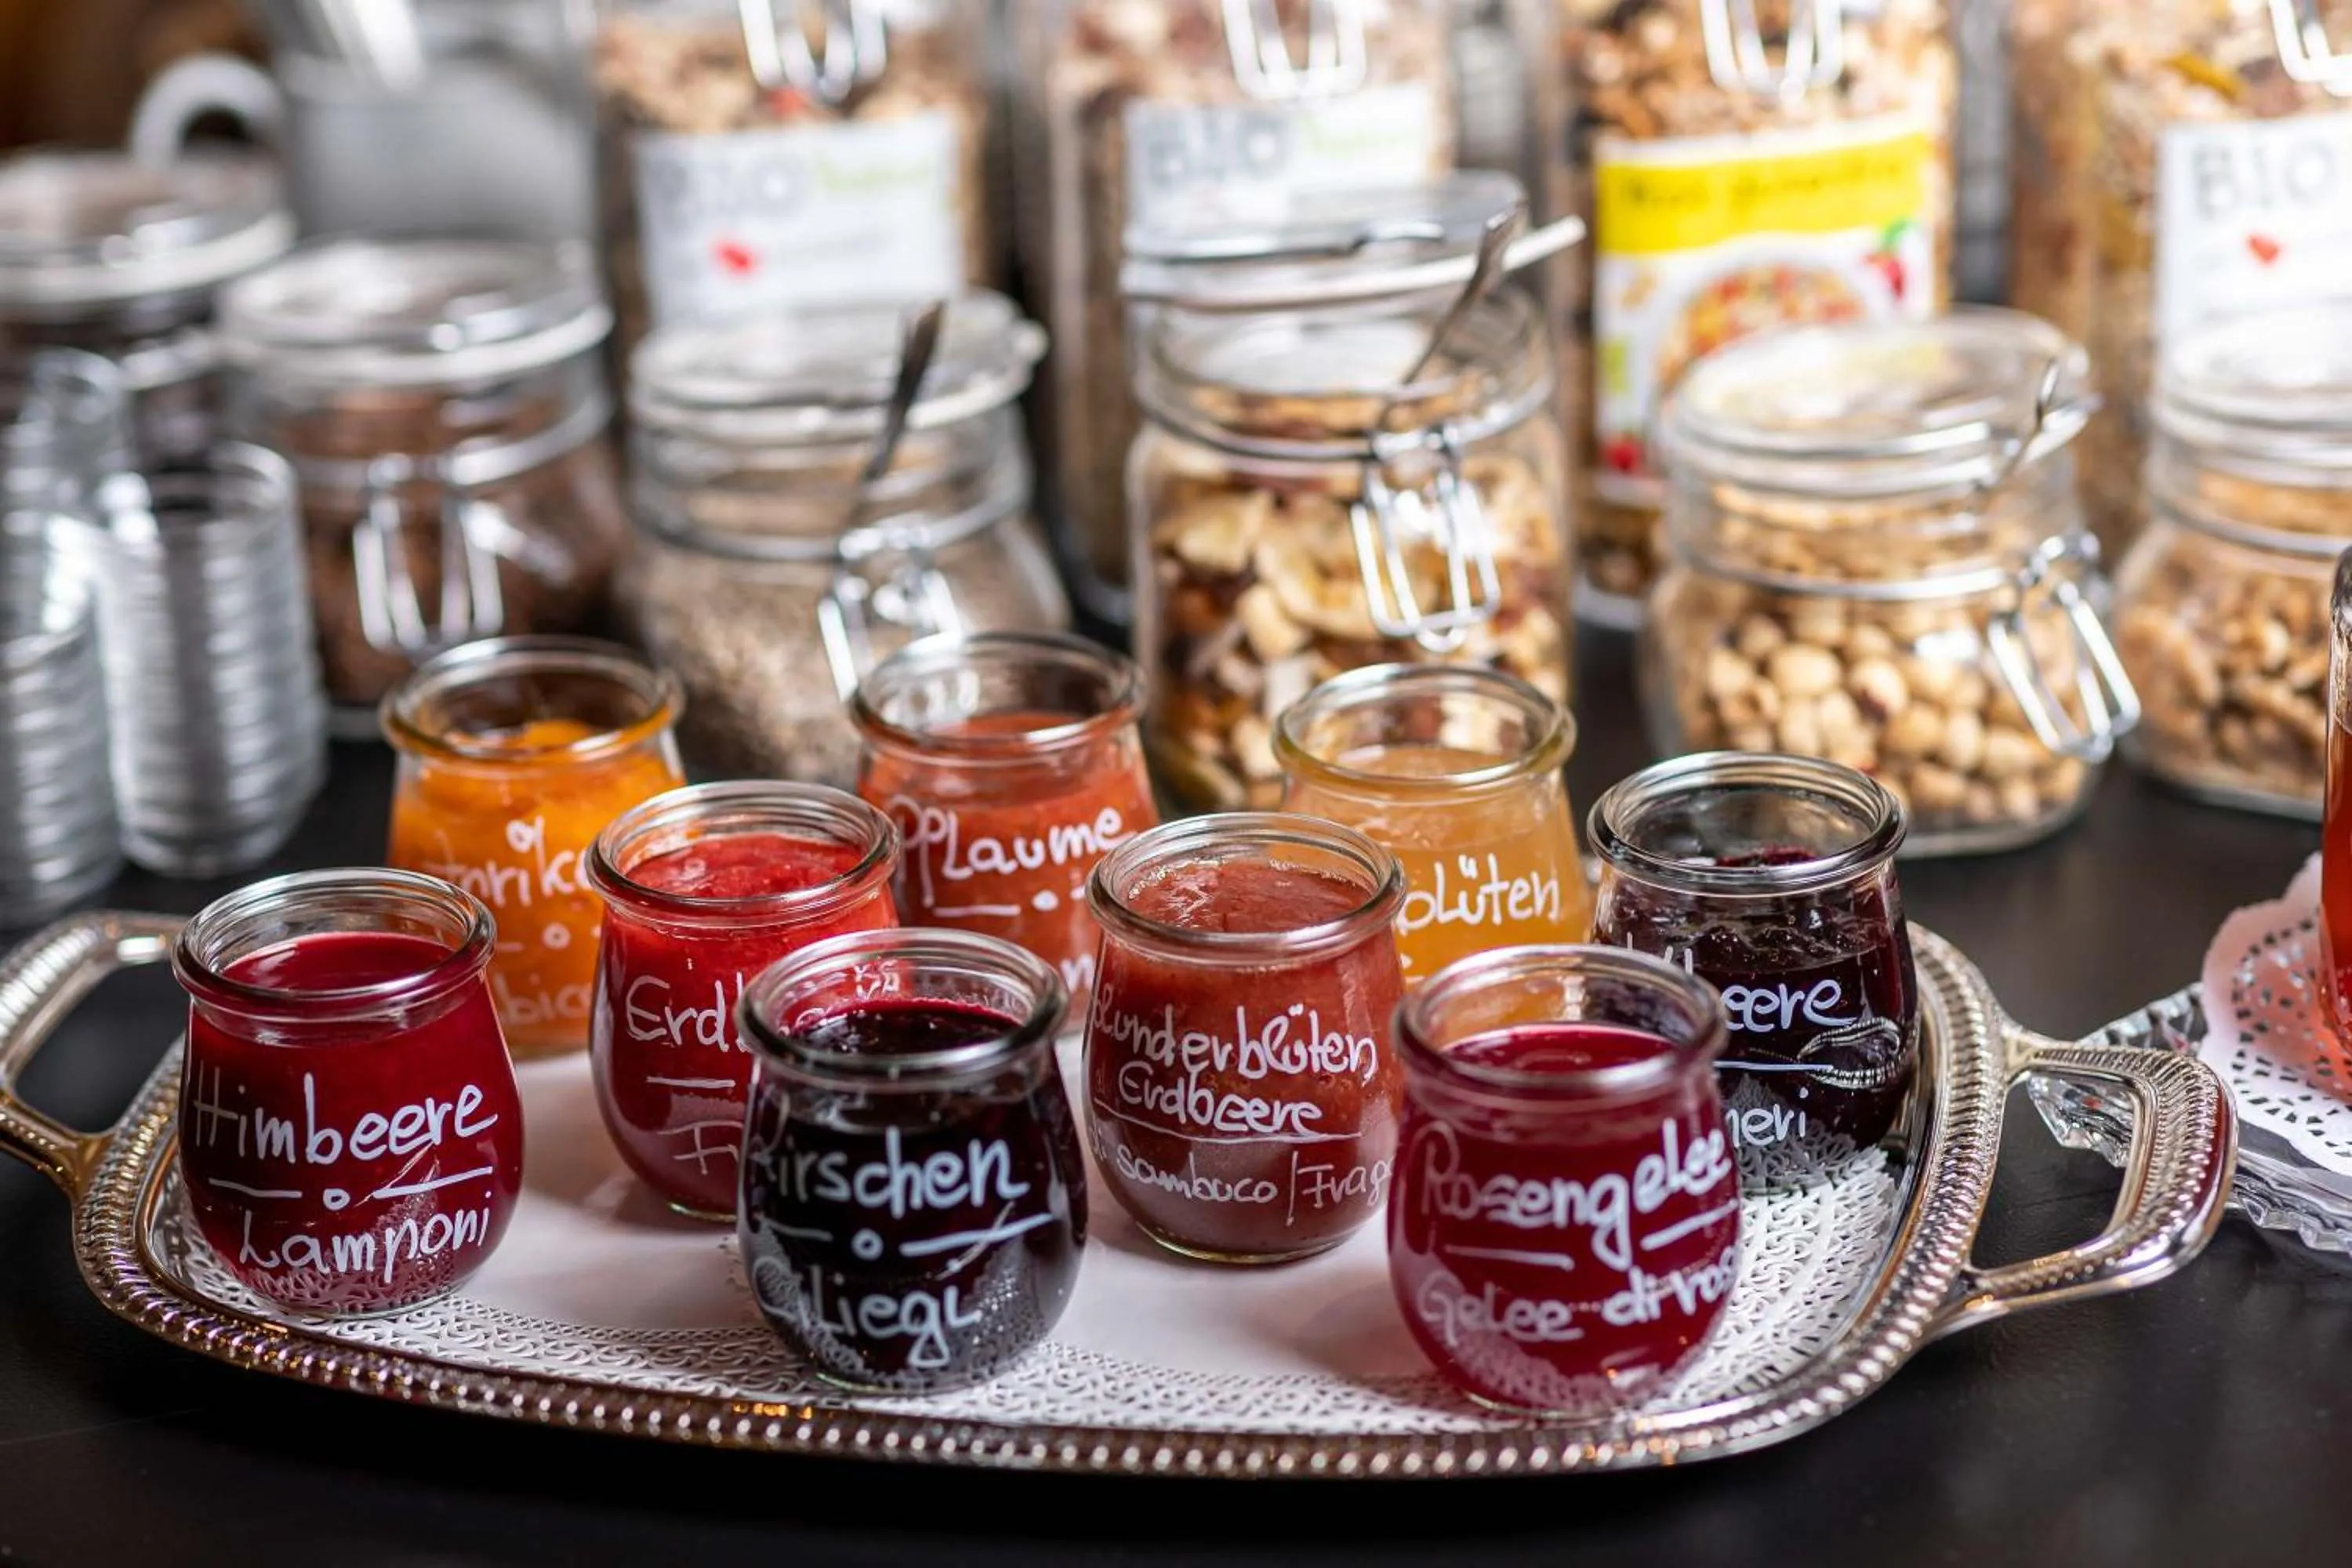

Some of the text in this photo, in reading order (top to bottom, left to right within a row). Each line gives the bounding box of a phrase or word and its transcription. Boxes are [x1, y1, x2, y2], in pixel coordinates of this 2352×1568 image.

[194, 1060, 499, 1166] Himbeere
[1119, 1061, 1323, 1137] Erdbeere
[239, 1191, 493, 1284] Lamponi
